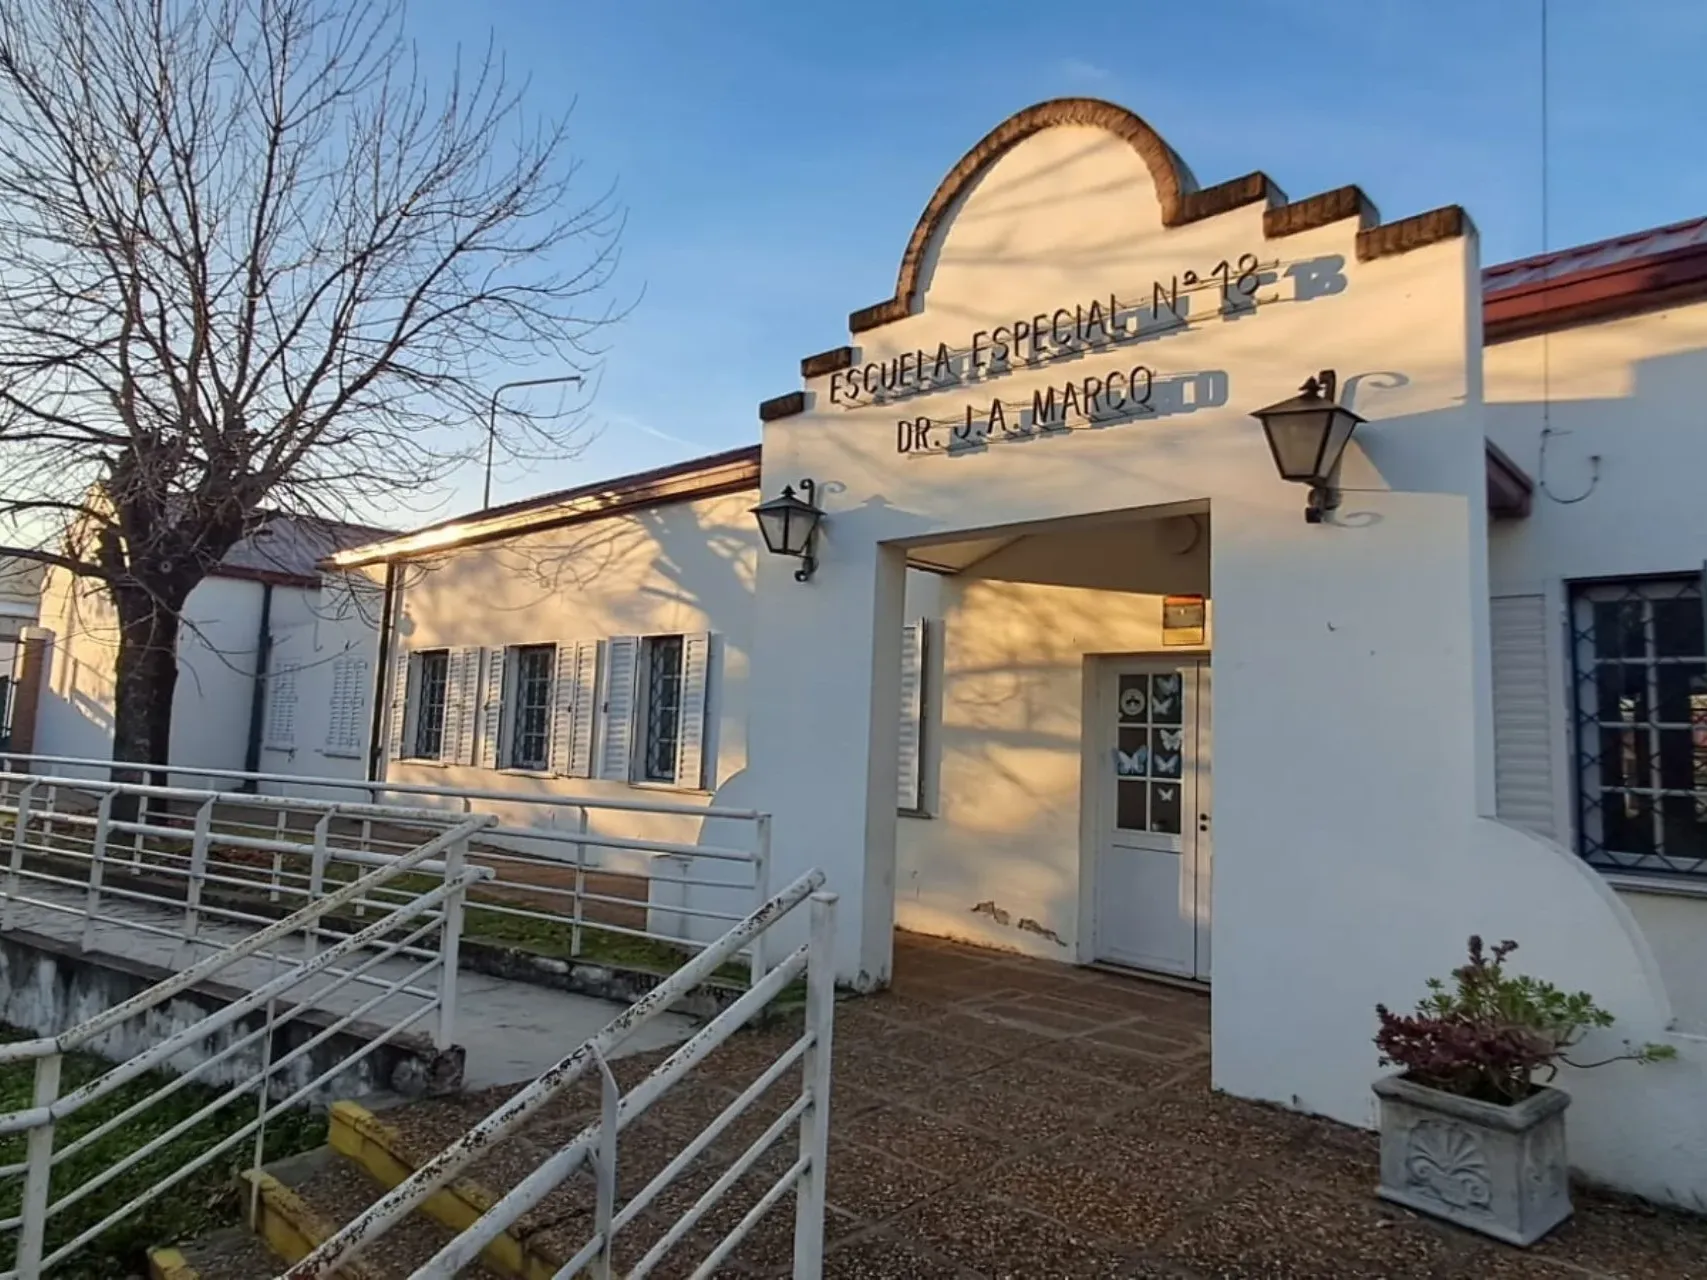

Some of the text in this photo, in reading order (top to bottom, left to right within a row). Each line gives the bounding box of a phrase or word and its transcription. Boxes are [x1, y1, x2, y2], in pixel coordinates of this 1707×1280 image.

[830, 342, 952, 404] ESCUELA
[972, 294, 1128, 367] ESPECIAL
[1211, 253, 1260, 301] 18
[898, 416, 941, 453] DR.
[1032, 366, 1153, 425] MARCO
